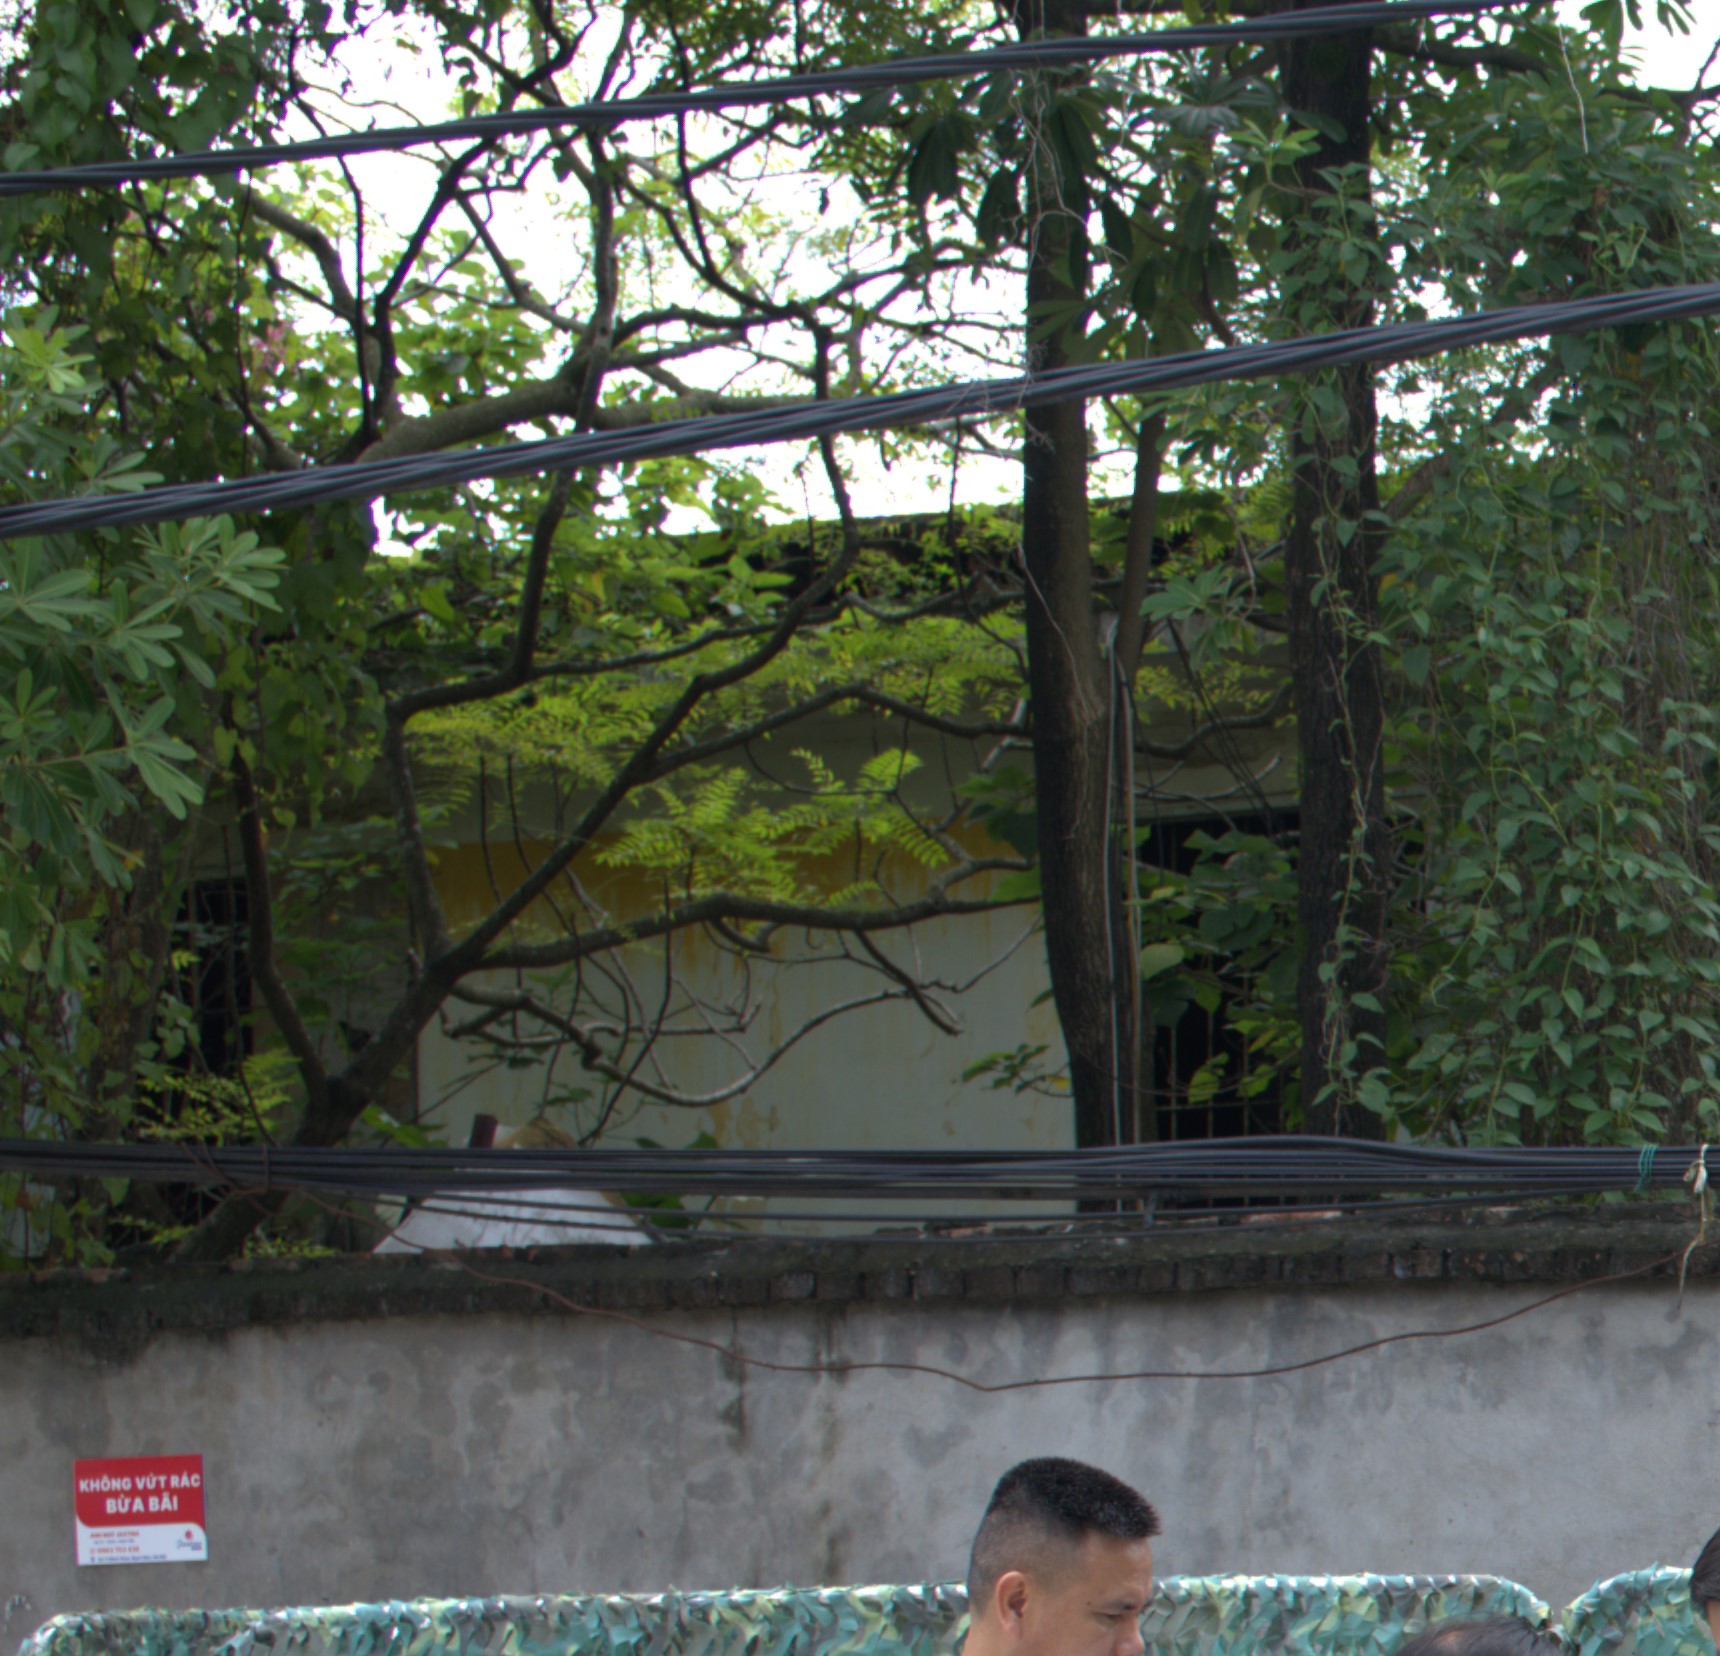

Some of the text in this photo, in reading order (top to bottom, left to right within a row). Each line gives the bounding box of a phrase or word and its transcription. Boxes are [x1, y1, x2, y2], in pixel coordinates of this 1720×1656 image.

[79, 1470, 201, 1493] KHÔNG VỨT RÁC
[148, 1491, 178, 1512] BÃI
